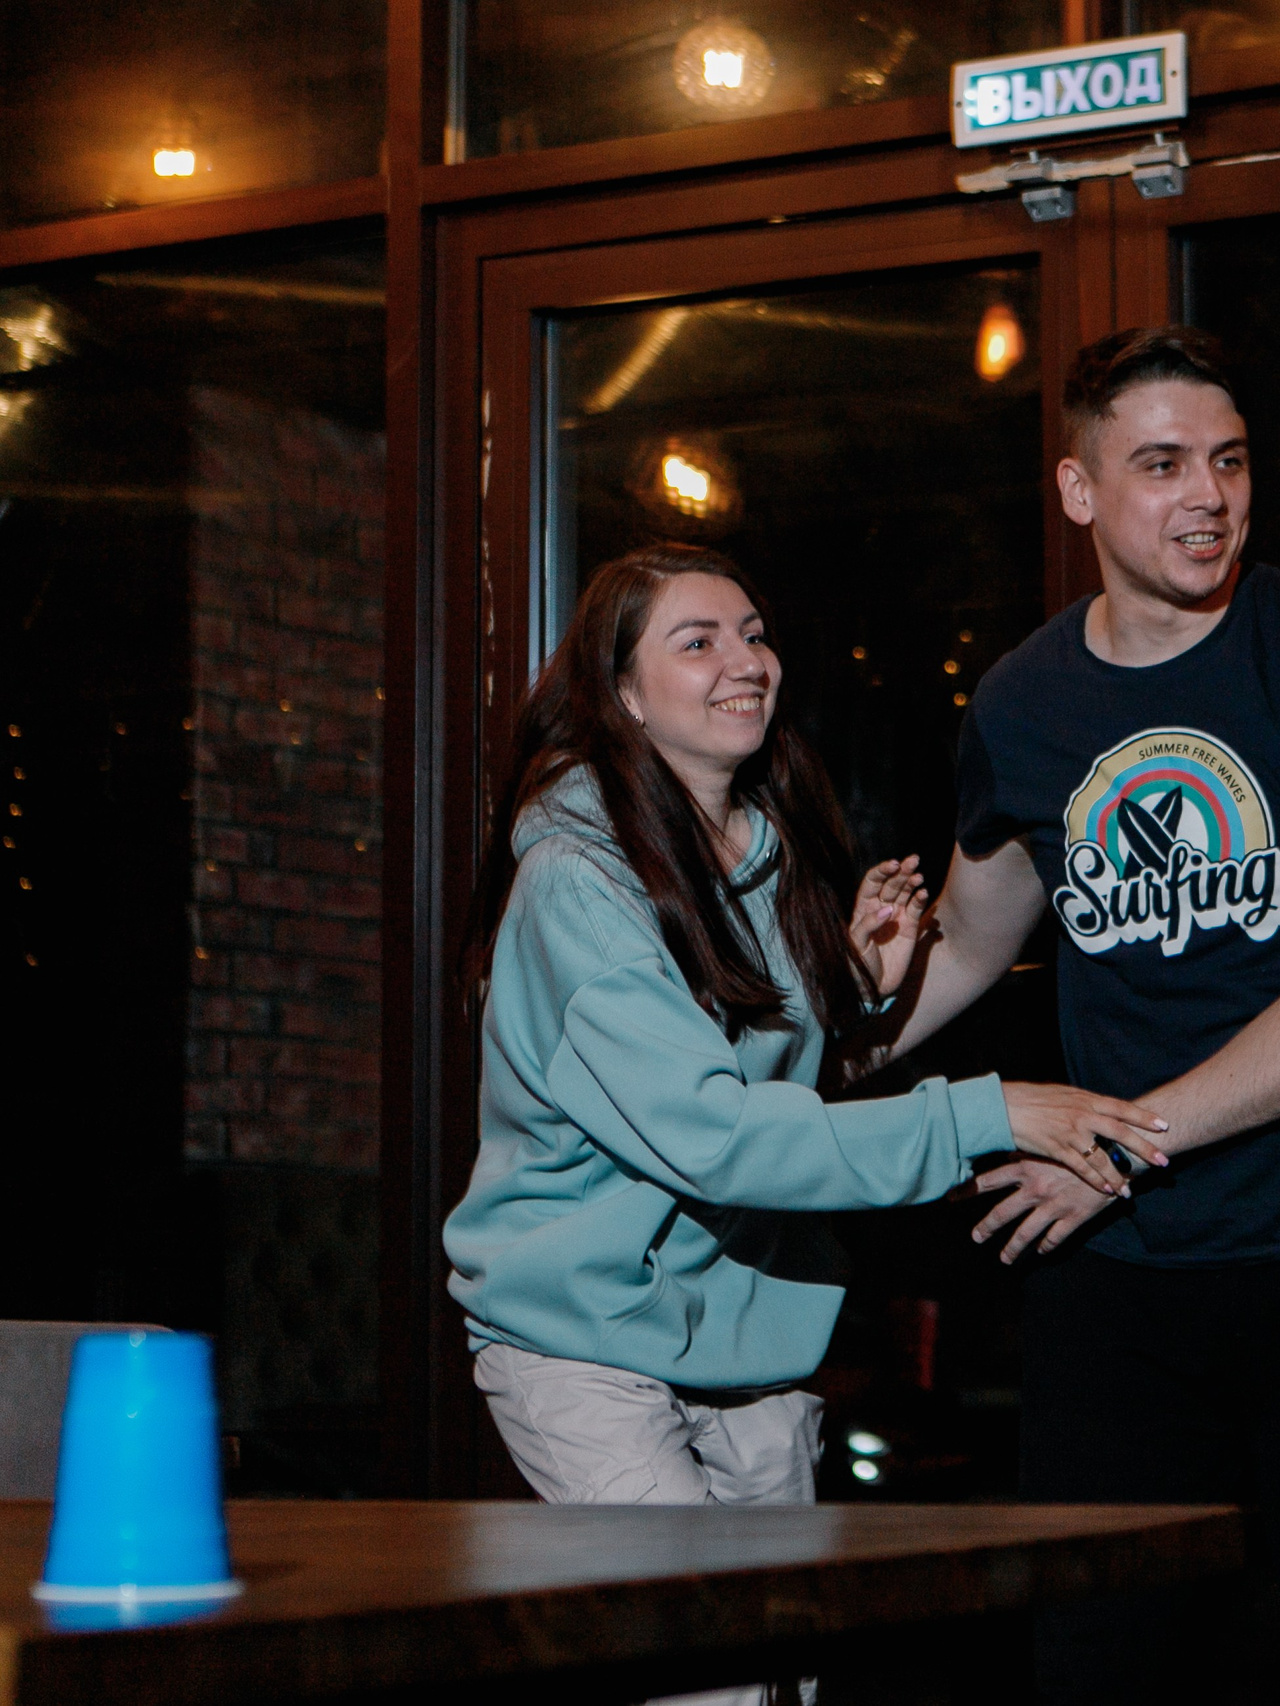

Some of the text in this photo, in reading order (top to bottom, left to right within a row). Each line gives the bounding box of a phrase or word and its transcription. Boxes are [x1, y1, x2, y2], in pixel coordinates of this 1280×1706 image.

[977, 57, 1162, 126] ВЫХОД
[1138, 743, 1247, 803] SUMMER FREE WAVES
[1055, 845, 1280, 943] Surfing
